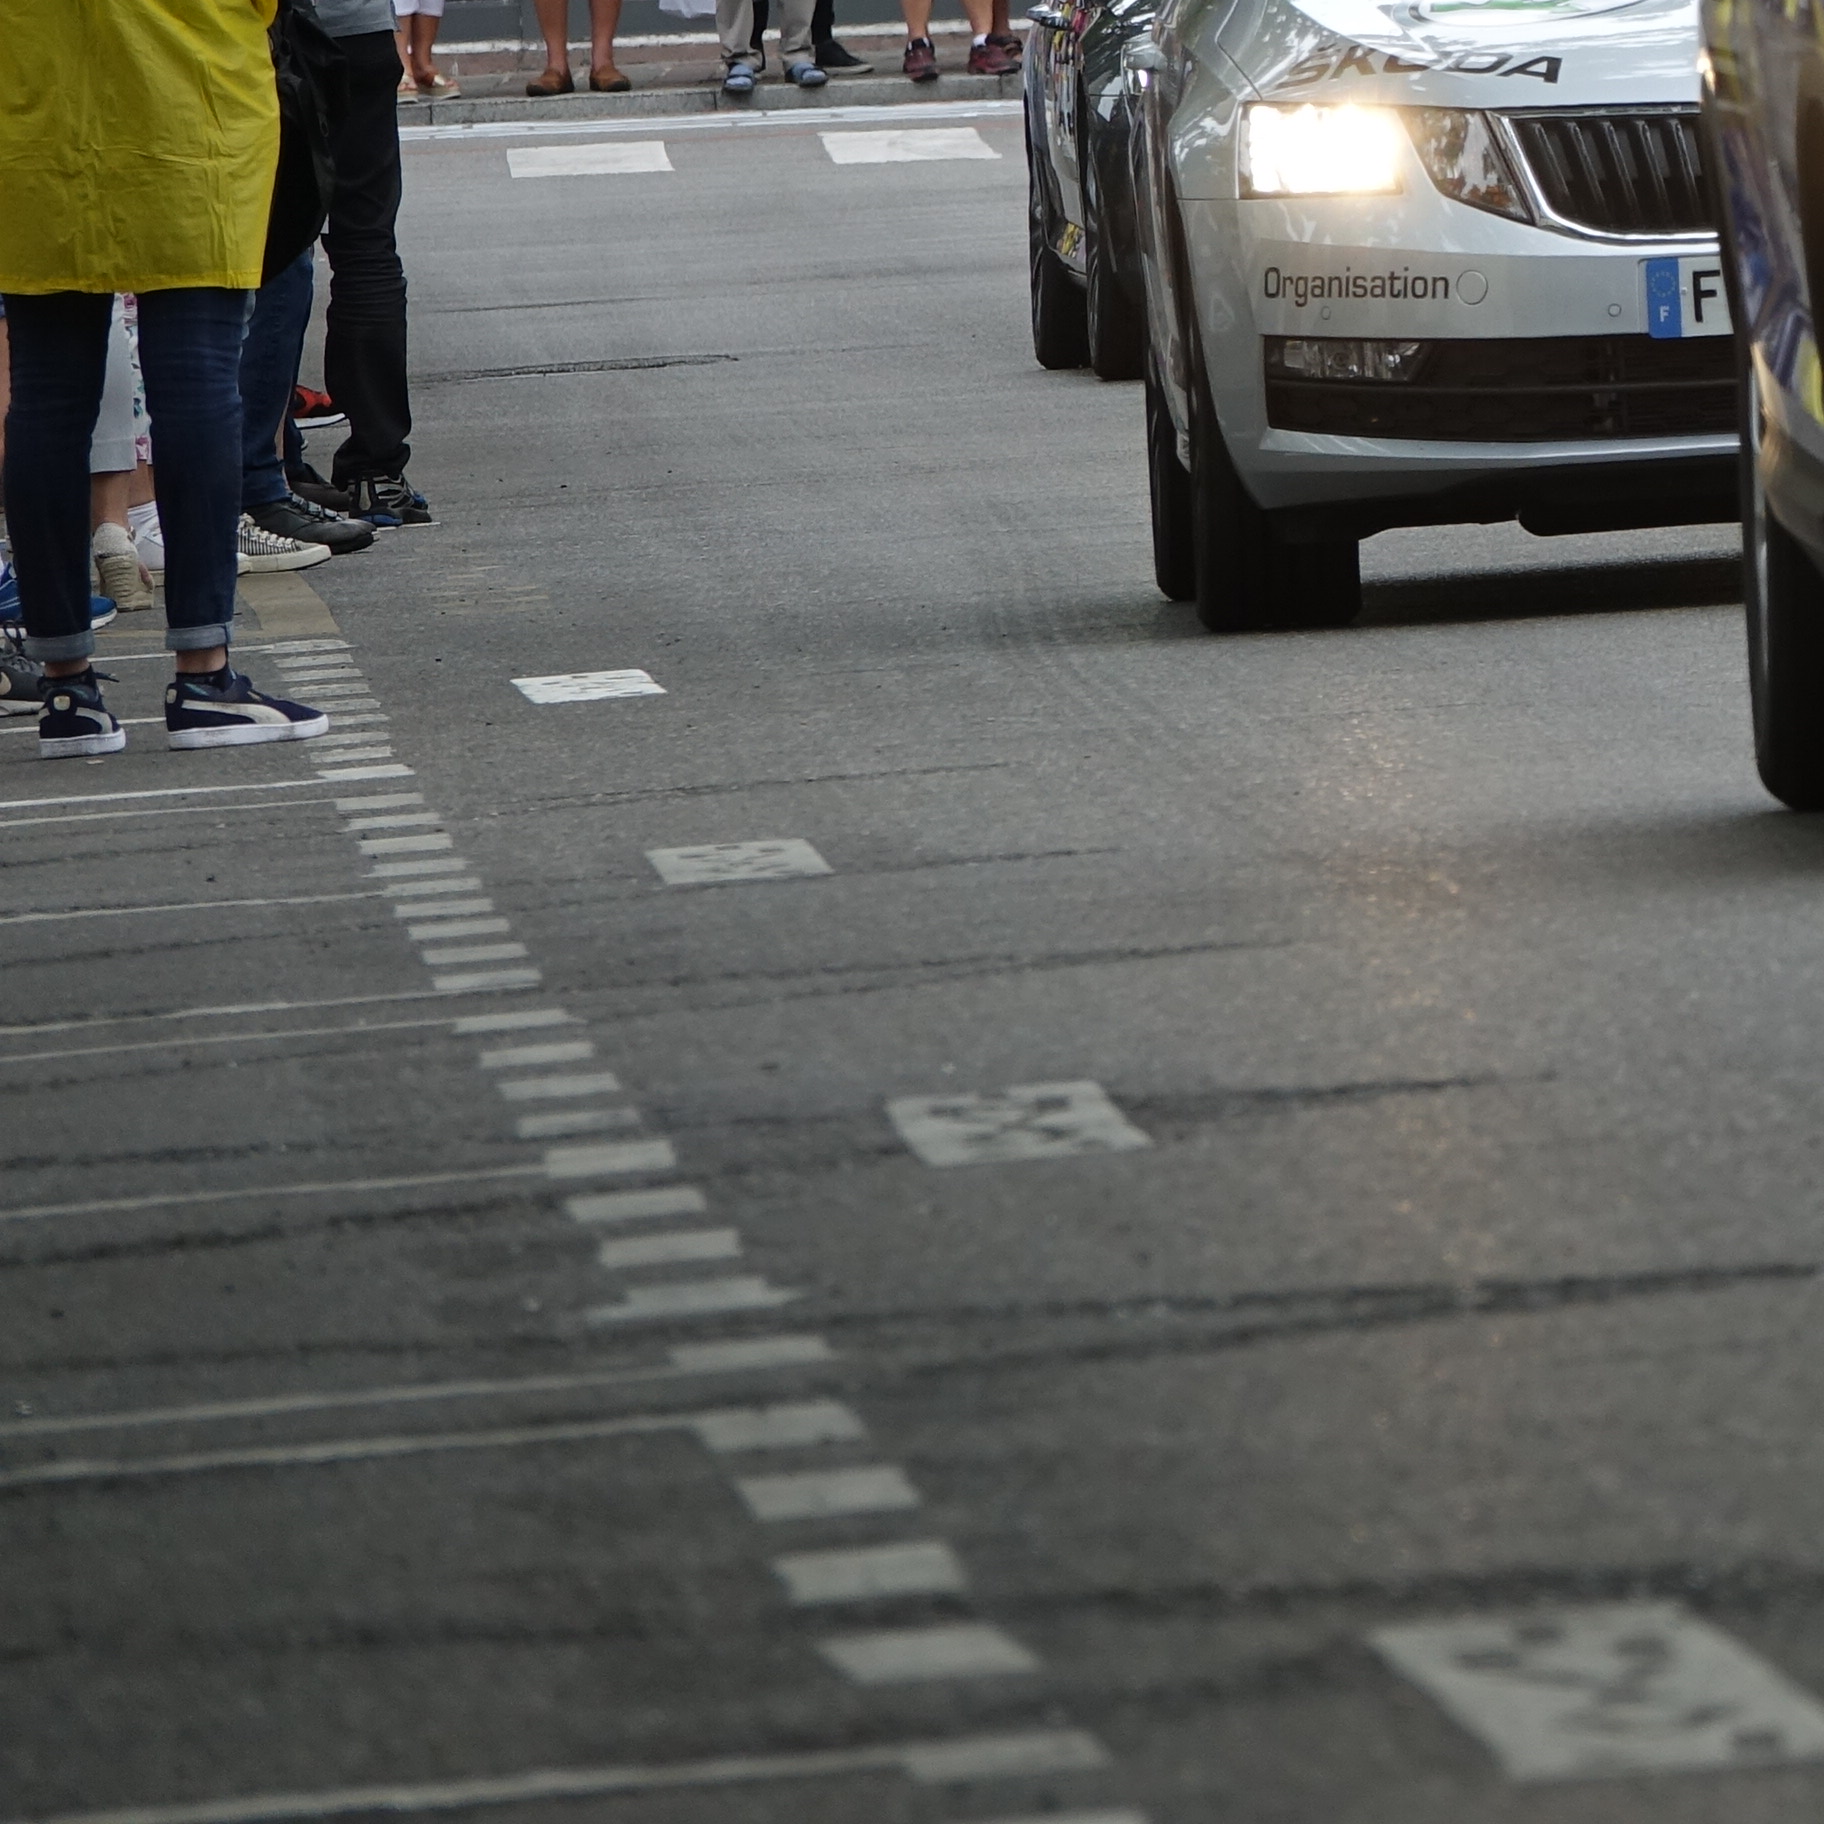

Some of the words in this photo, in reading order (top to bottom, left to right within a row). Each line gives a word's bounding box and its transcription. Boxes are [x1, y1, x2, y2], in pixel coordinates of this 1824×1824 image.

[1263, 266, 1450, 308] Organisation
[1691, 269, 1722, 323] F
[1658, 305, 1670, 323] F
